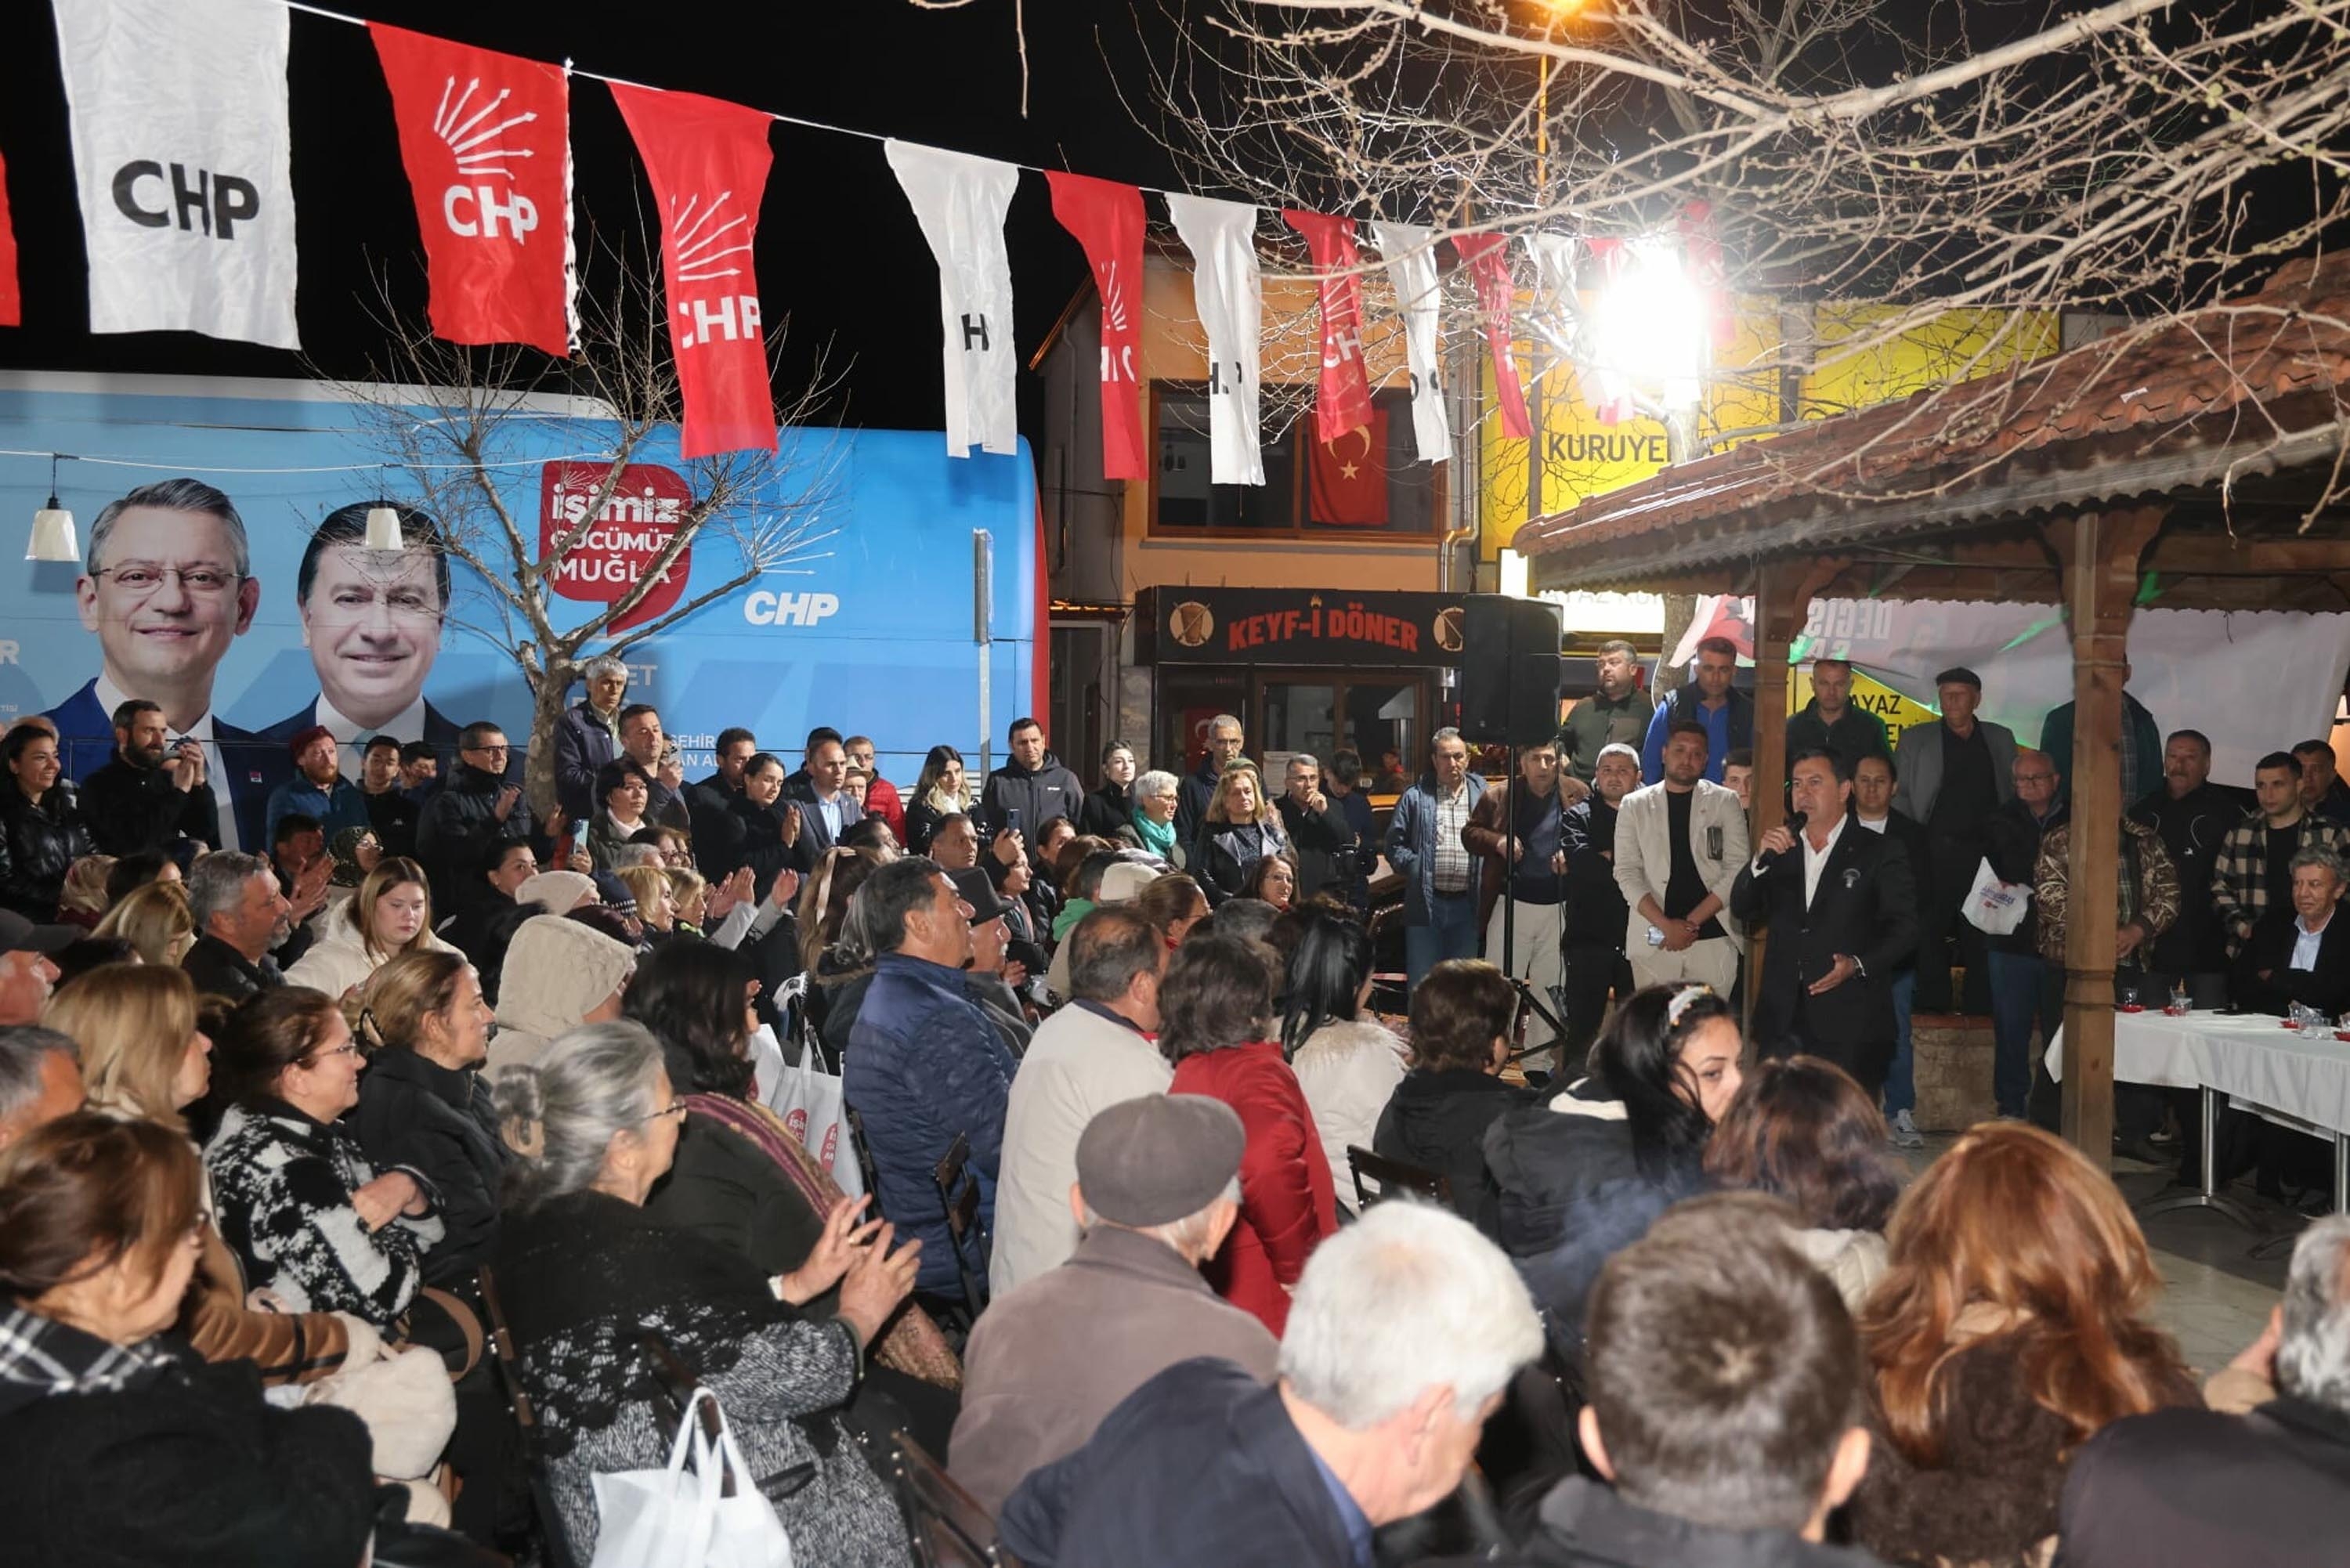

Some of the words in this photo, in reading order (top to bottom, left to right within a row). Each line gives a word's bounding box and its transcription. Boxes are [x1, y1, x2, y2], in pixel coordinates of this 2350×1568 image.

[112, 159, 260, 241] CHP
[444, 185, 539, 247] CHP
[1549, 433, 1671, 463] KURUYE
[744, 591, 839, 626] CHP
[1328, 602, 1419, 652] DÖNER
